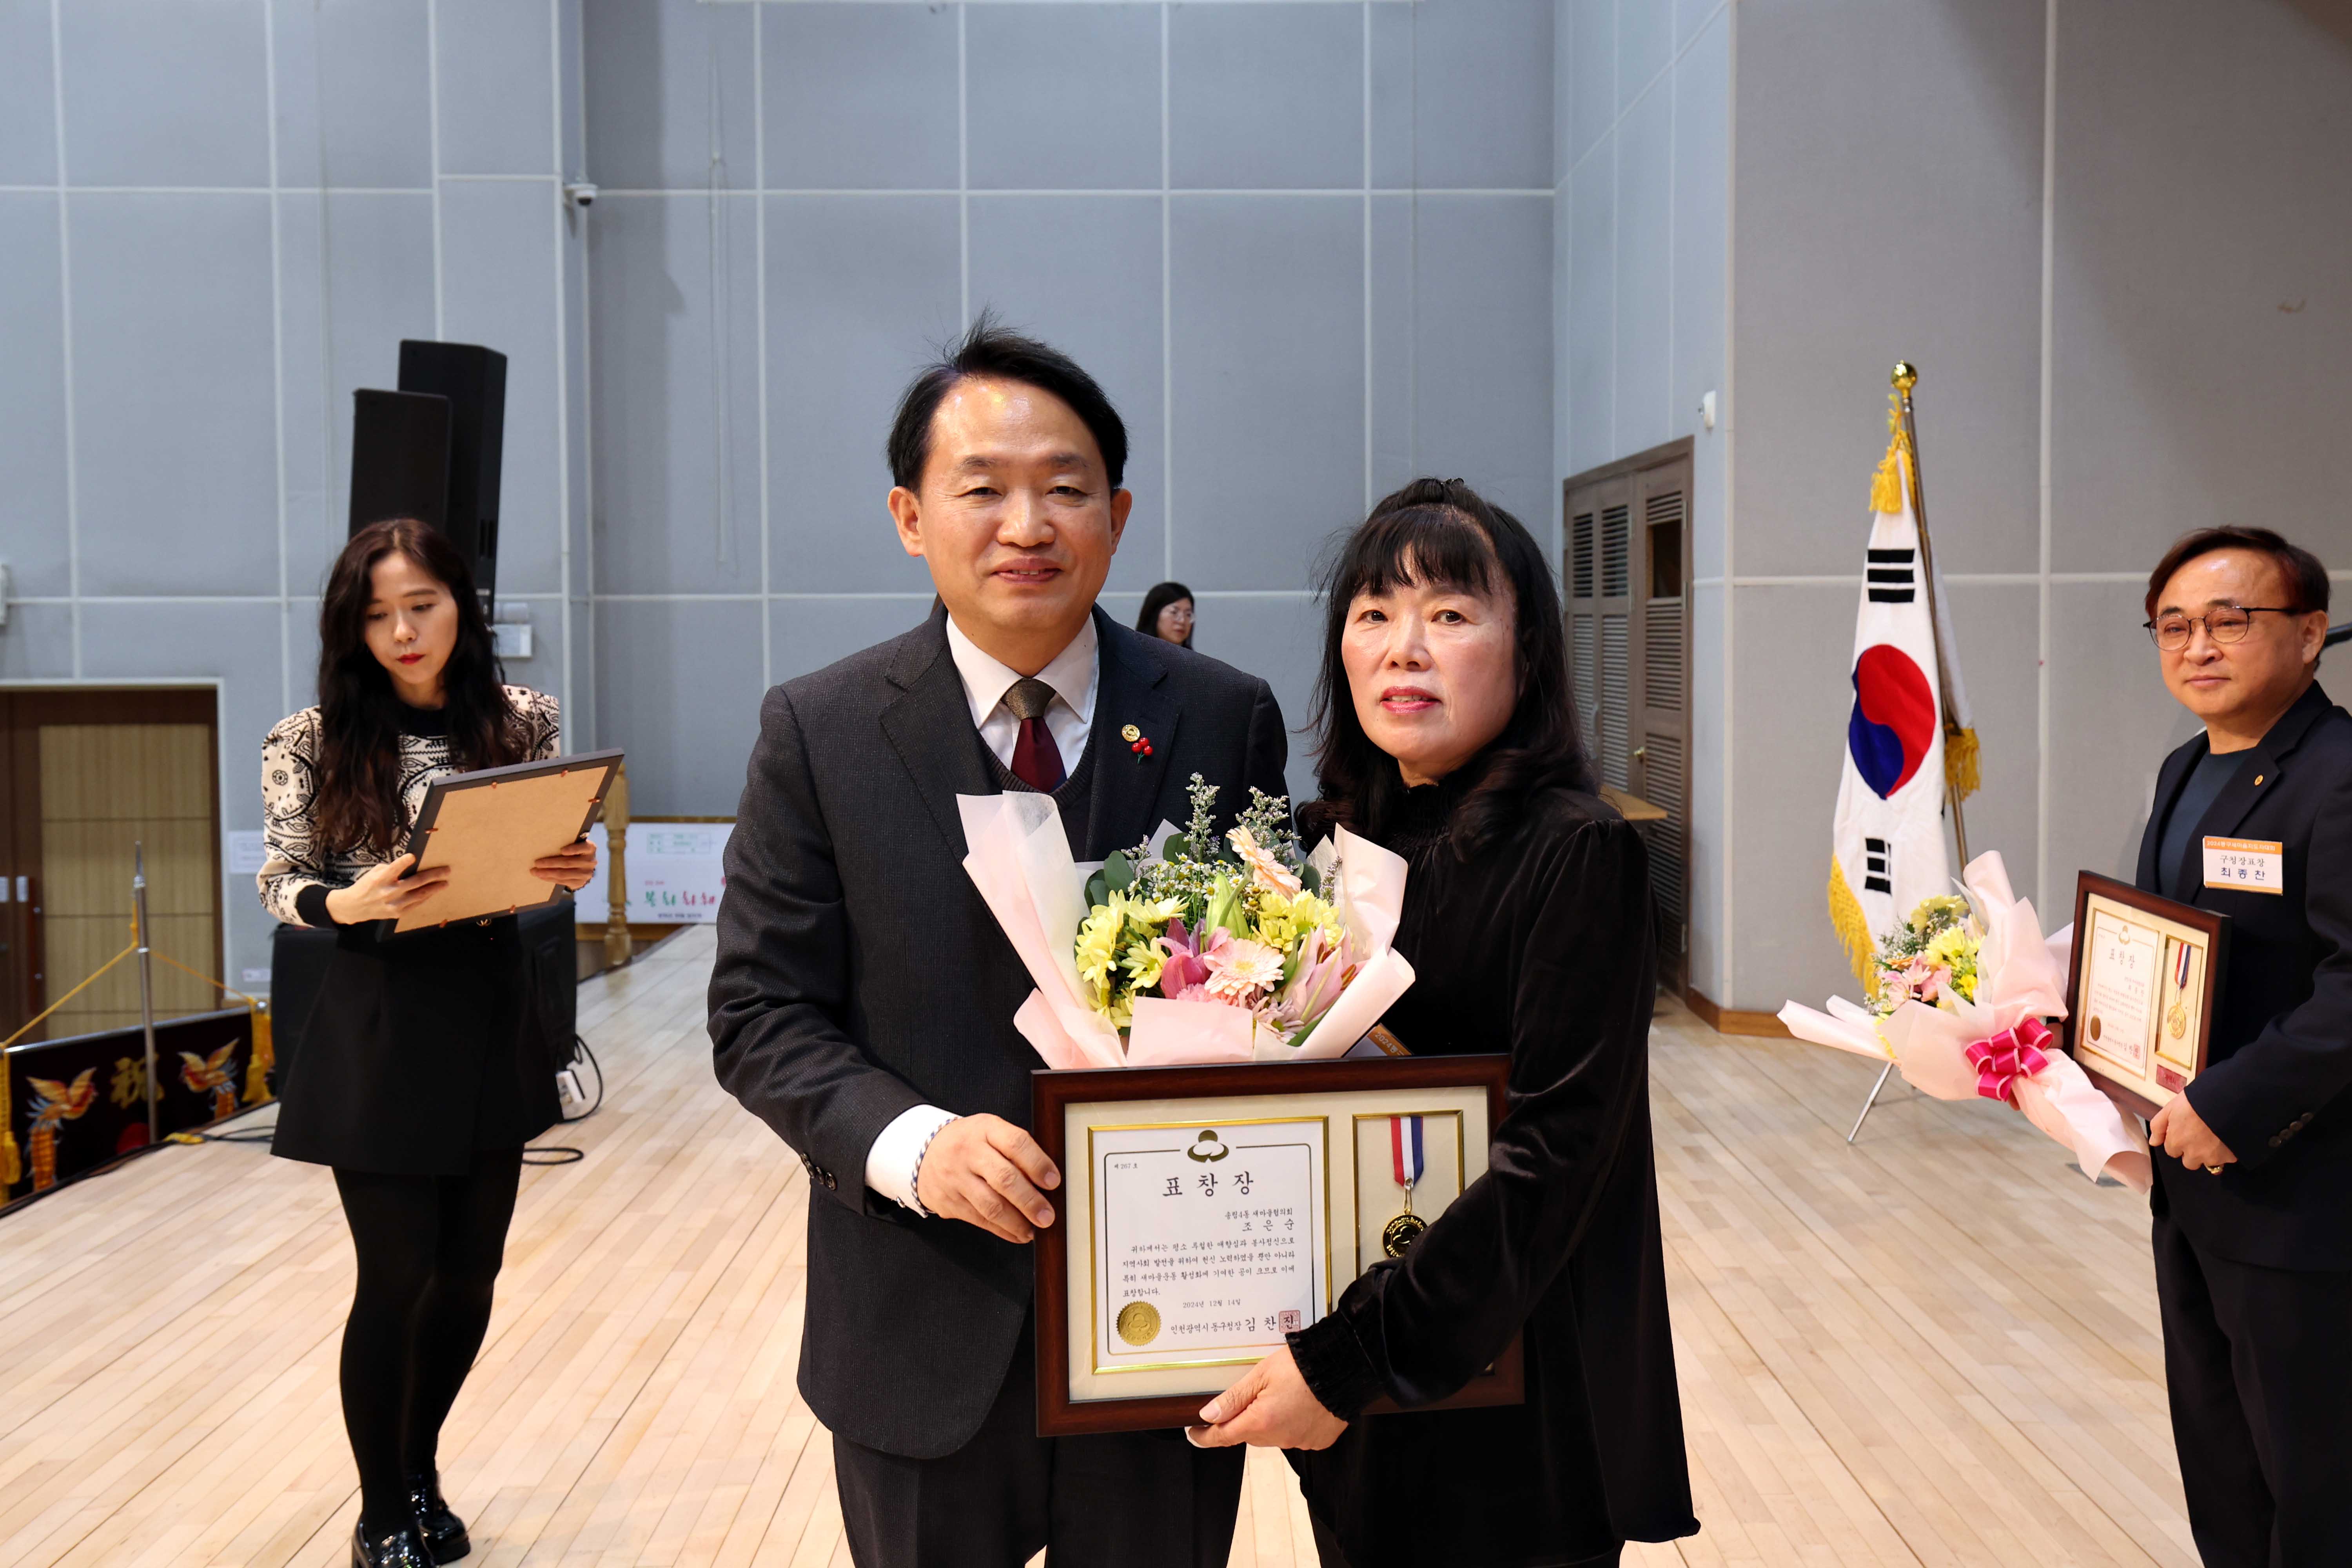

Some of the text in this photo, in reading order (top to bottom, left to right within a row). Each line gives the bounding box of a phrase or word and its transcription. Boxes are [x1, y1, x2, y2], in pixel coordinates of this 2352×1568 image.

[1225, 1207, 1292, 1220] 송림4동 새마을협의회
[1131, 1237, 1295, 1254] 귀하께서는 평소 투철한 애향심과 봉사정신으로
[1122, 1250, 1295, 1269] 지역사회 발전을 위하여 헌신 노력하였을 뿐만 아니라
[1122, 1265, 1294, 1283] 특히 새마을운동 활성화에 기여한 공이 크므로 이에
[1122, 1287, 1160, 1298] 표창합니다.
[1171, 1323, 1209, 1334] 인천광역시
[1211, 1320, 1242, 1332] 동구청장
